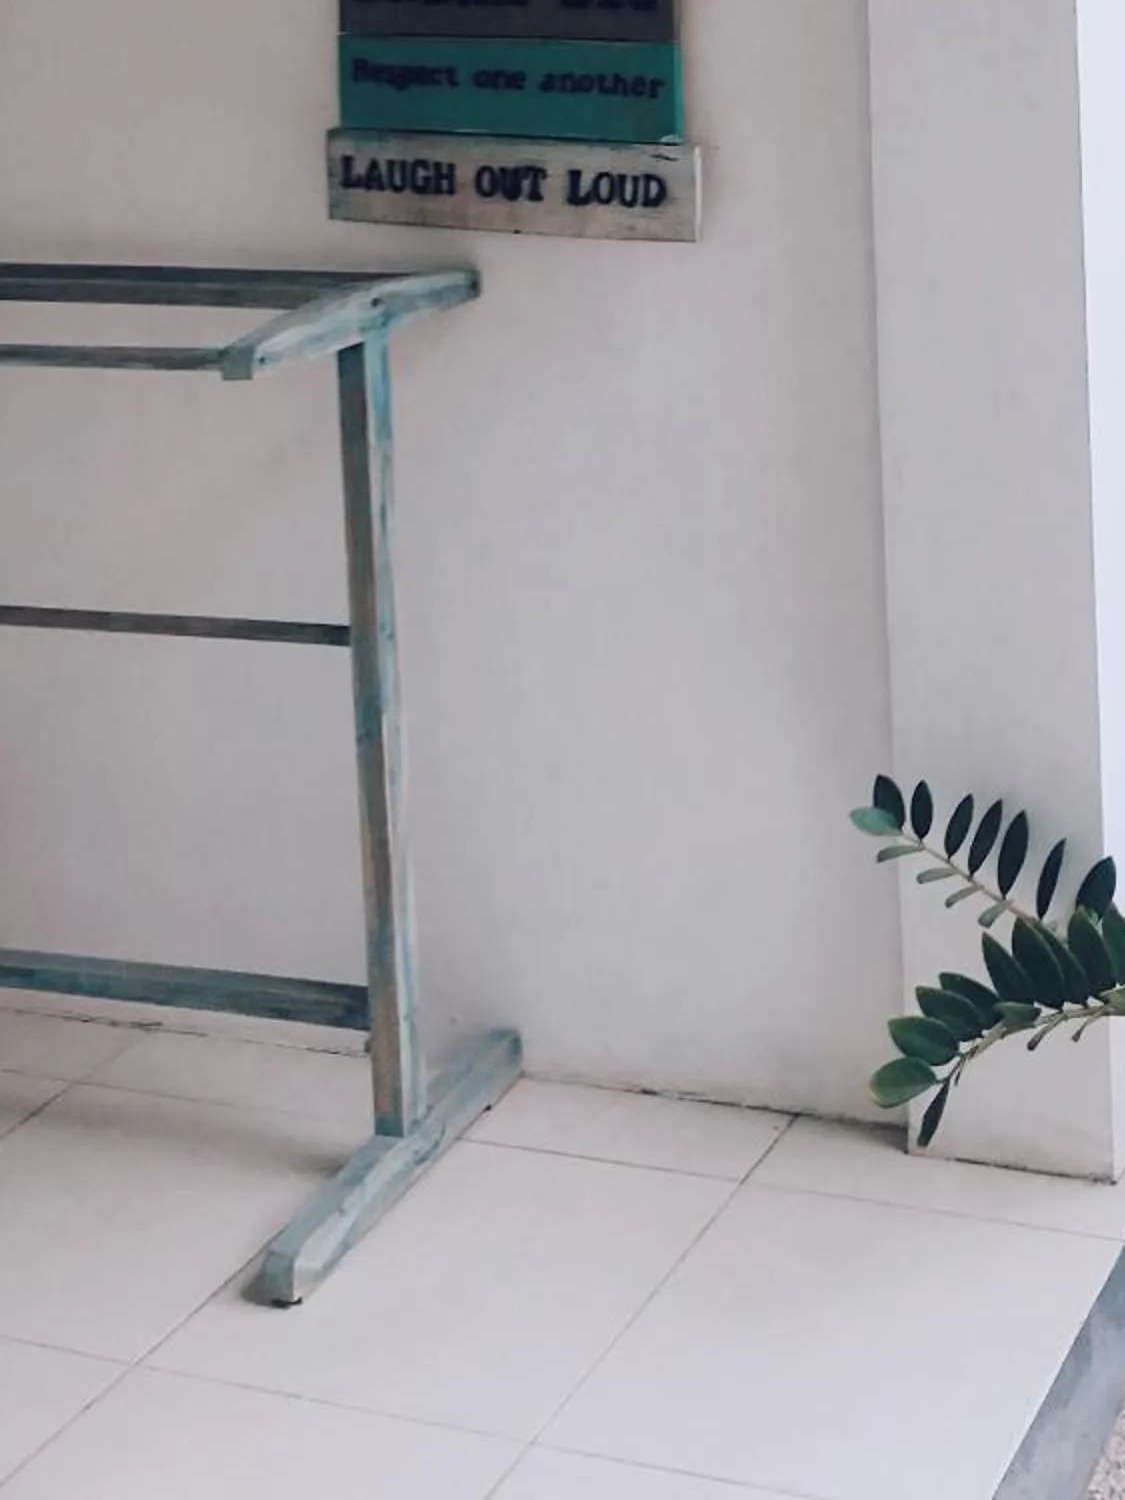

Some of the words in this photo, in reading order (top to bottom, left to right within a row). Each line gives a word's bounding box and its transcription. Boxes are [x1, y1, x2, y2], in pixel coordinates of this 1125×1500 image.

[473, 67, 525, 92] one
[539, 71, 664, 99] another
[340, 155, 456, 196] LAUGH
[475, 166, 548, 202] OUT
[566, 170, 667, 209] LOUD
